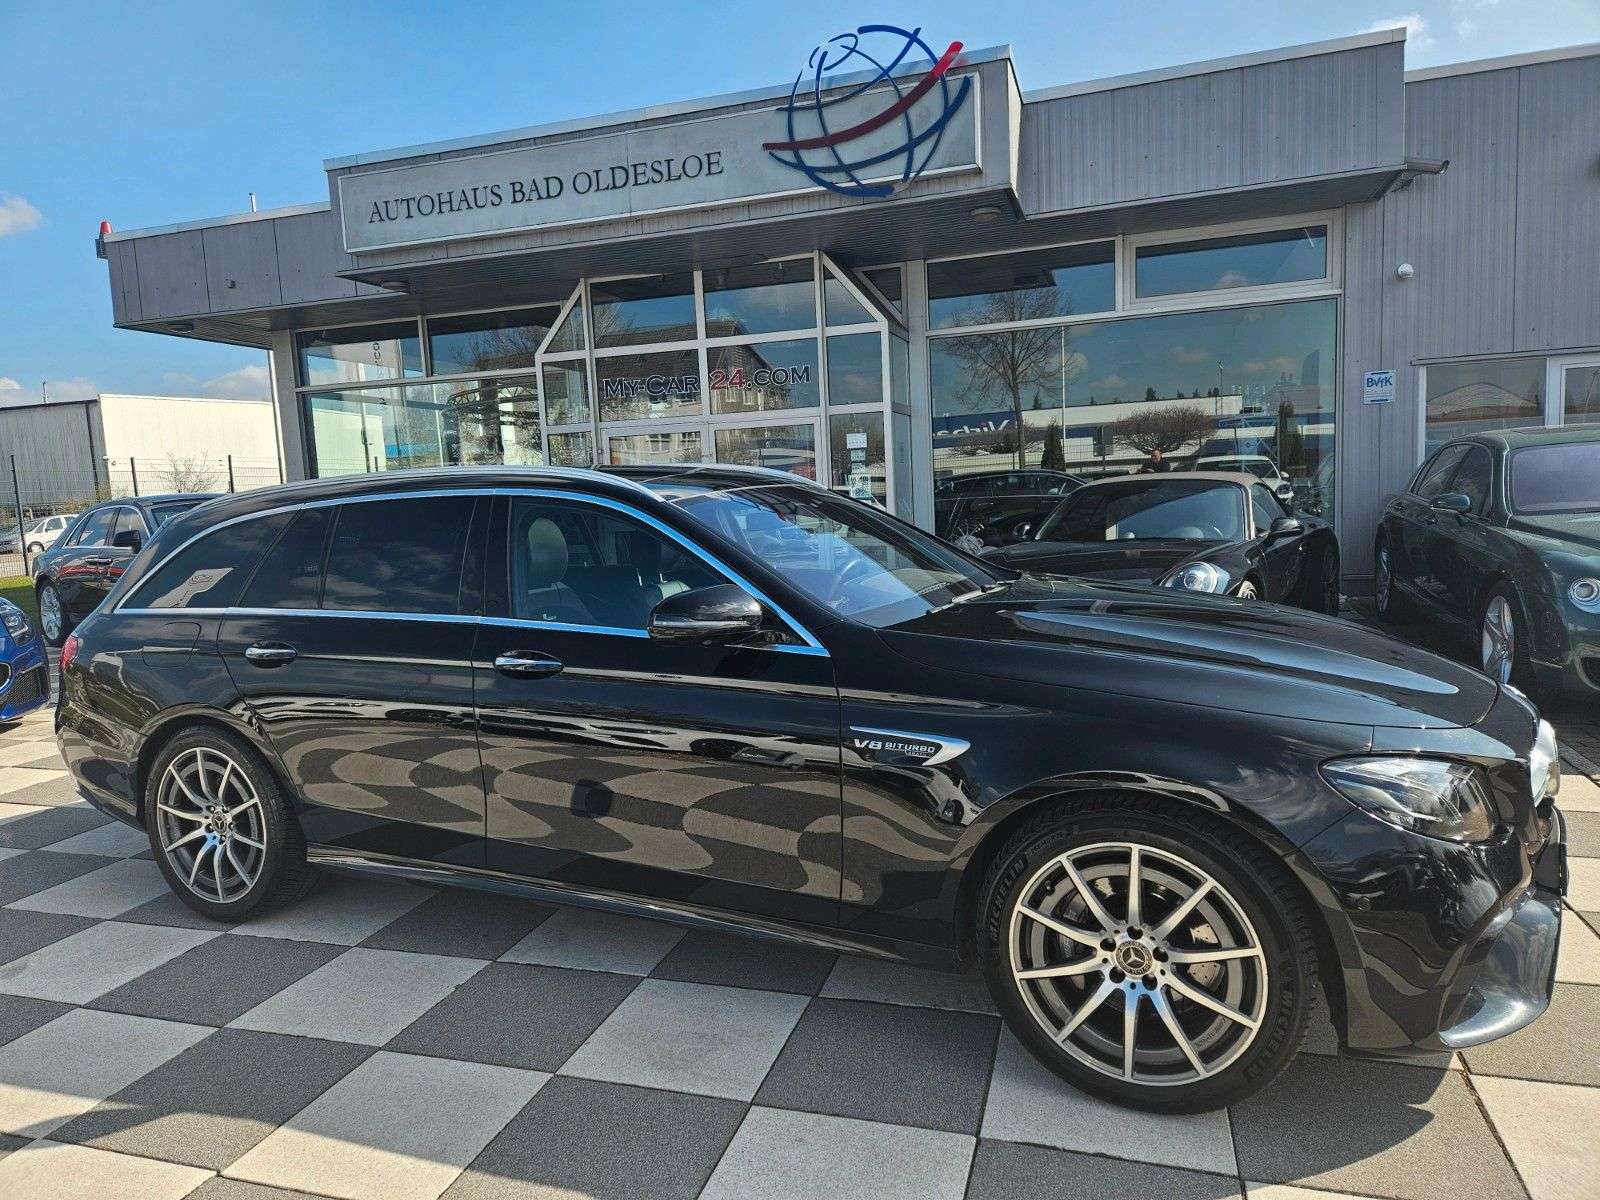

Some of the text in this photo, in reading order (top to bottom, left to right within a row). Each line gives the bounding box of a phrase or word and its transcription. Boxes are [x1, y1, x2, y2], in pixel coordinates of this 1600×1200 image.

[368, 151, 724, 224] AUTOHAUS BAD OLDESLOE
[854, 738, 935, 753] V8 BITURBO
